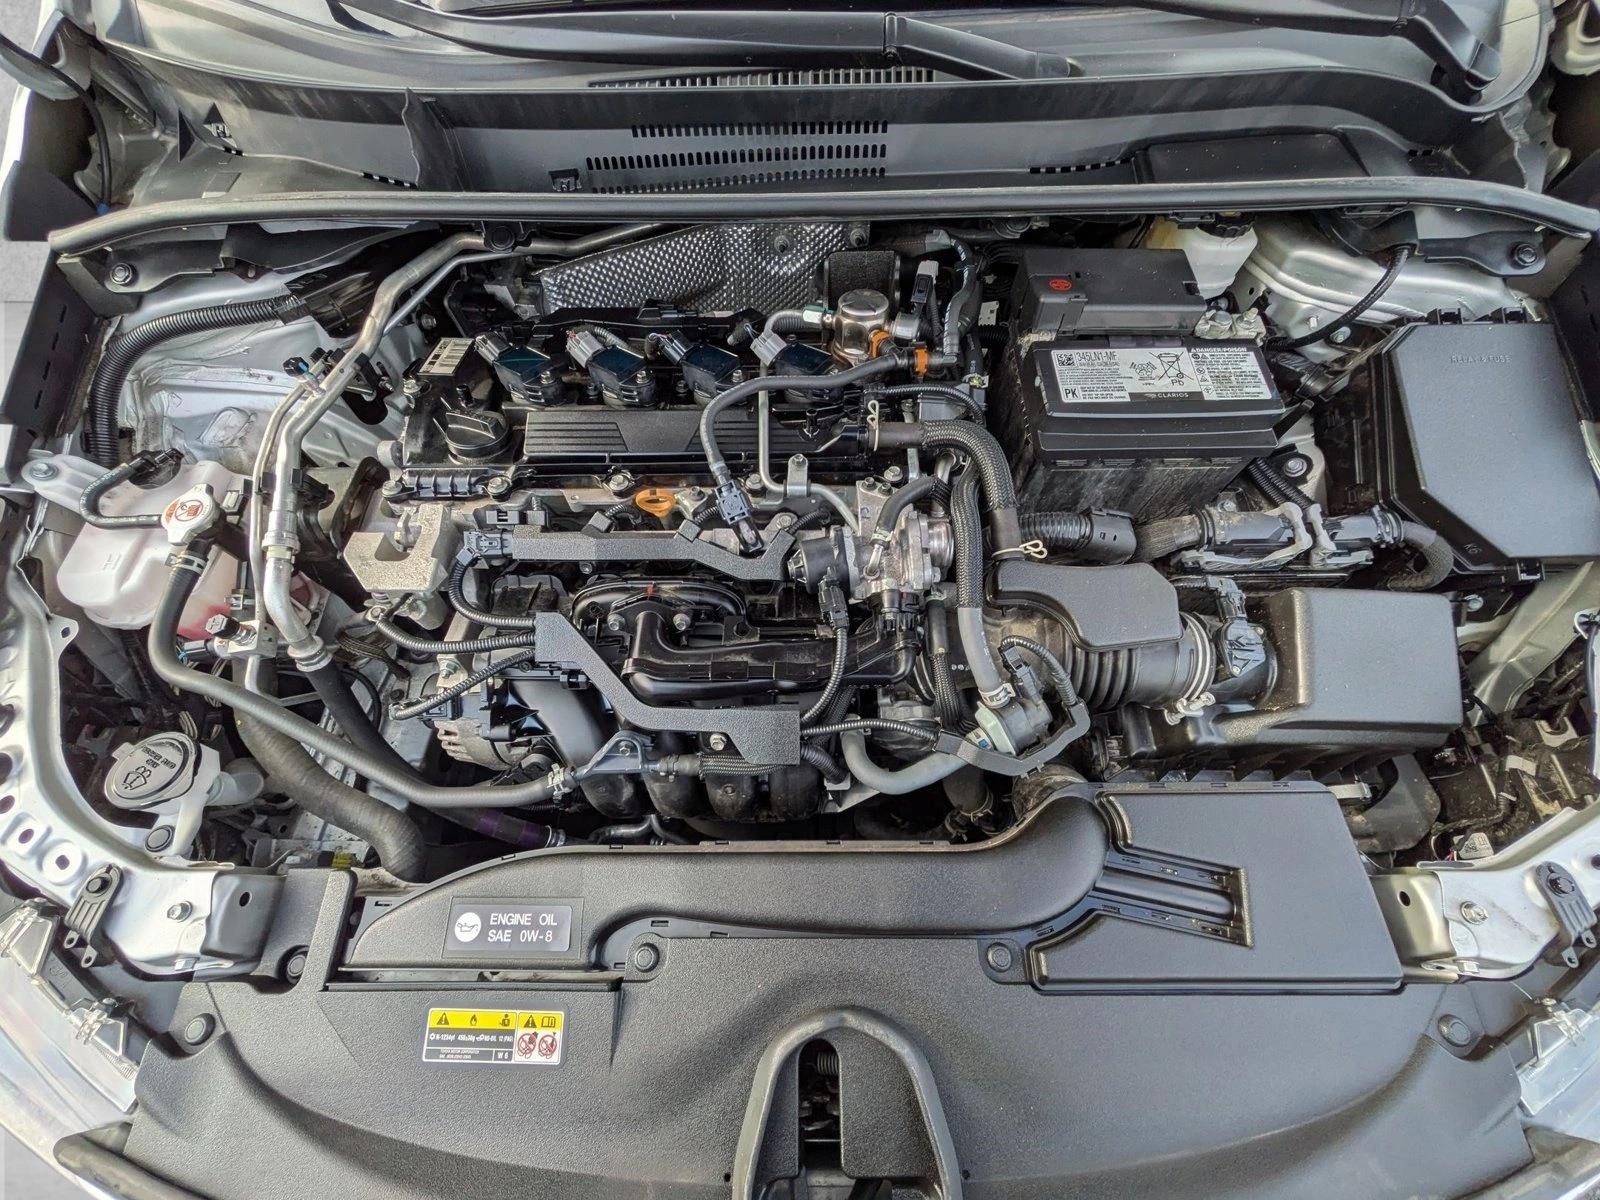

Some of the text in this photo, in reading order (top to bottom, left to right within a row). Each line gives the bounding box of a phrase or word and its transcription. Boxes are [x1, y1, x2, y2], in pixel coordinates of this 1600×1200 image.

[1171, 378, 1185, 386] Pb
[1064, 388, 1079, 399] PK
[489, 913, 558, 926] ENGINE OIL
[487, 929, 553, 943] SAE 0W-8
[497, 1052, 504, 1060] W
